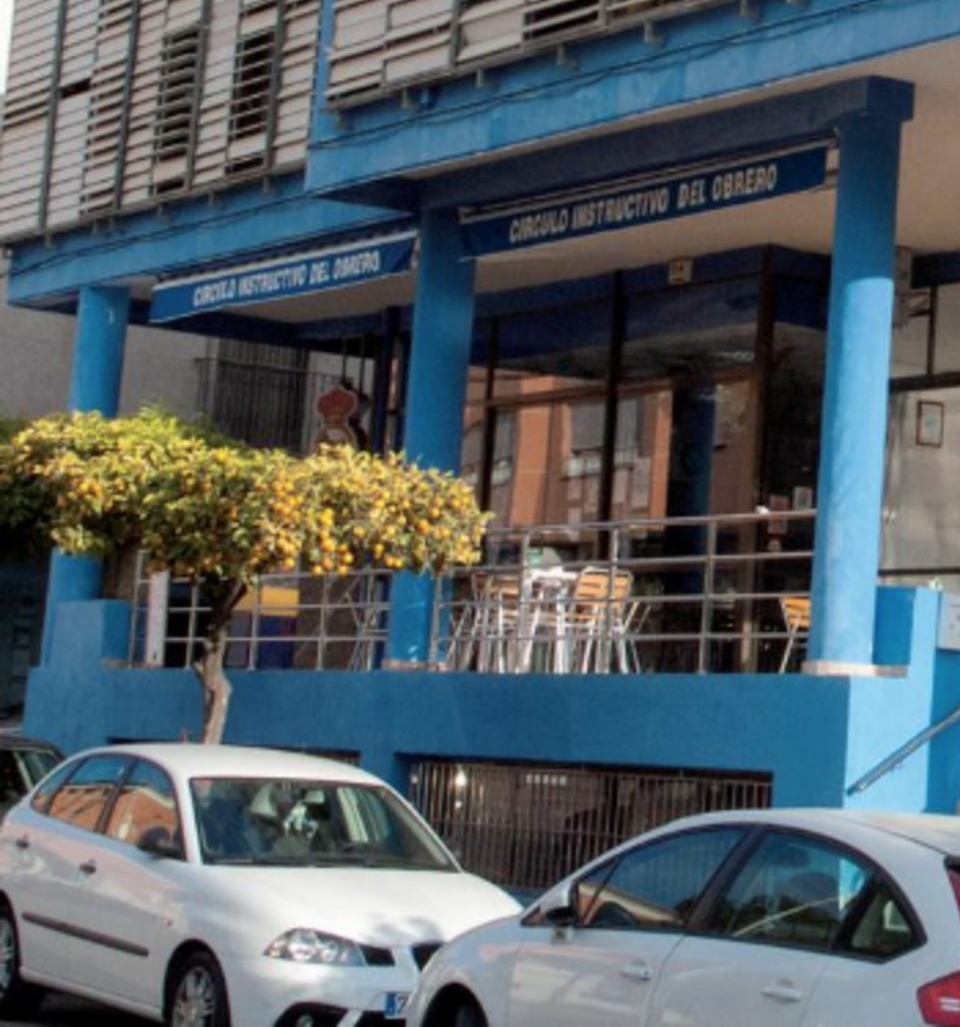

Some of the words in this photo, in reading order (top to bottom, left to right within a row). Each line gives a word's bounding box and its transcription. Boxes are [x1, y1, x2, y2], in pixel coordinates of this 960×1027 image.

[509, 207, 569, 244] CIRCULO
[571, 187, 669, 229] INSTRUCTIVO
[677, 179, 705, 209] DEL
[711, 163, 777, 202] OBRERO
